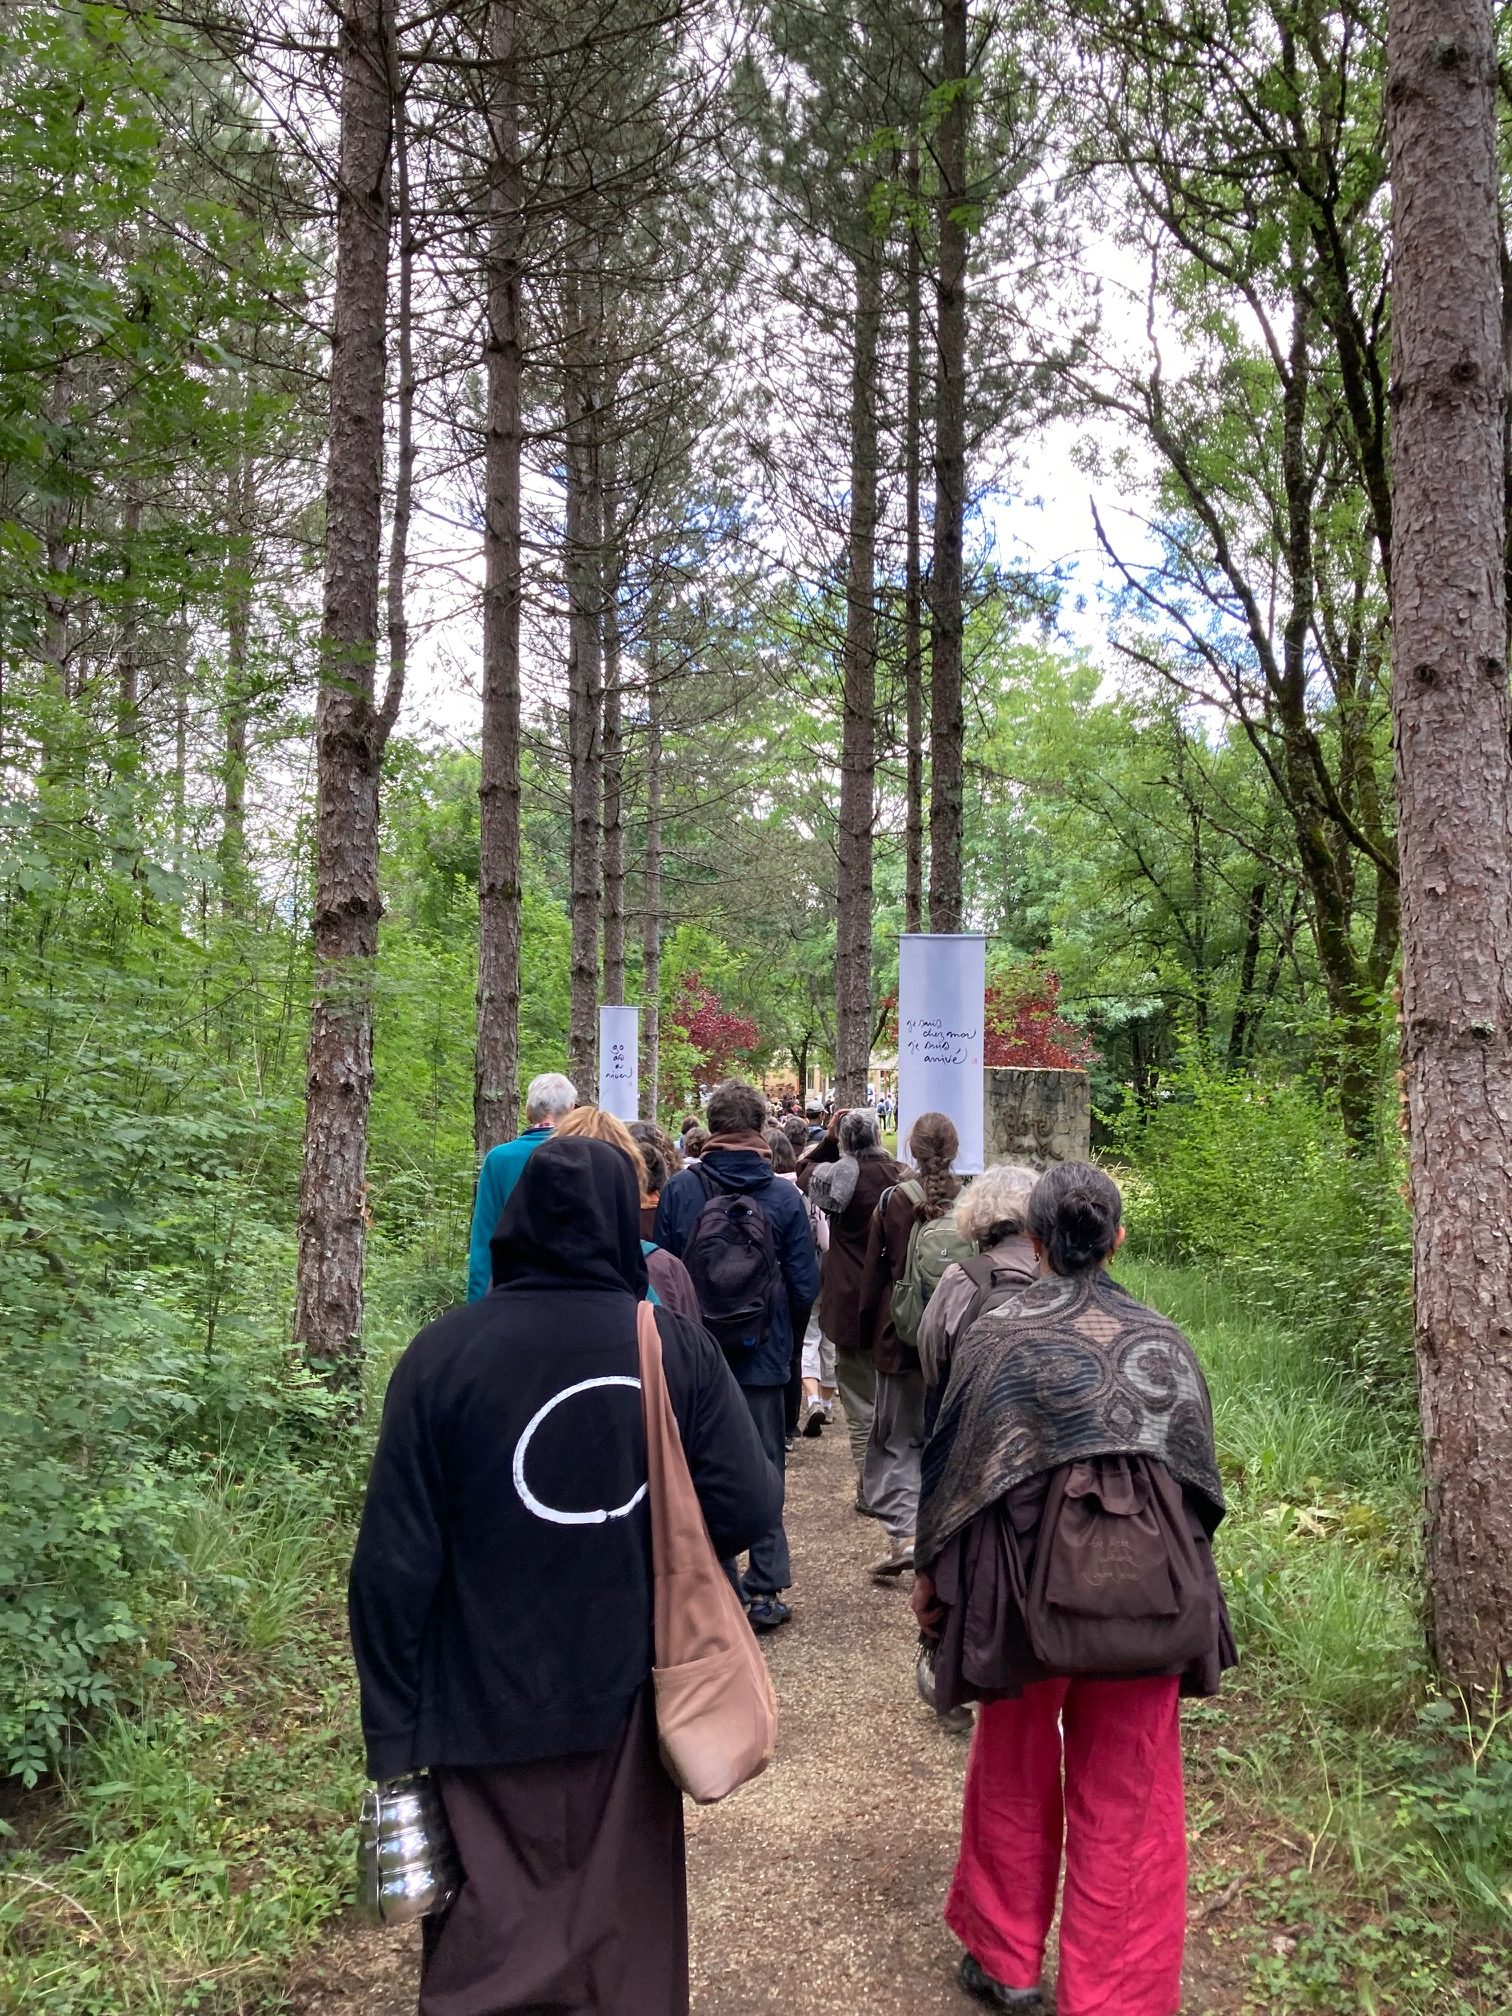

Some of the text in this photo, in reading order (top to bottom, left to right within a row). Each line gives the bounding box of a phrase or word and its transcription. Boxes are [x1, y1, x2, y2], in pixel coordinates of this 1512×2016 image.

[922, 1028, 945, 1042] chez
[908, 1040, 950, 1055] je suis
[923, 1048, 968, 1065] arrivé
